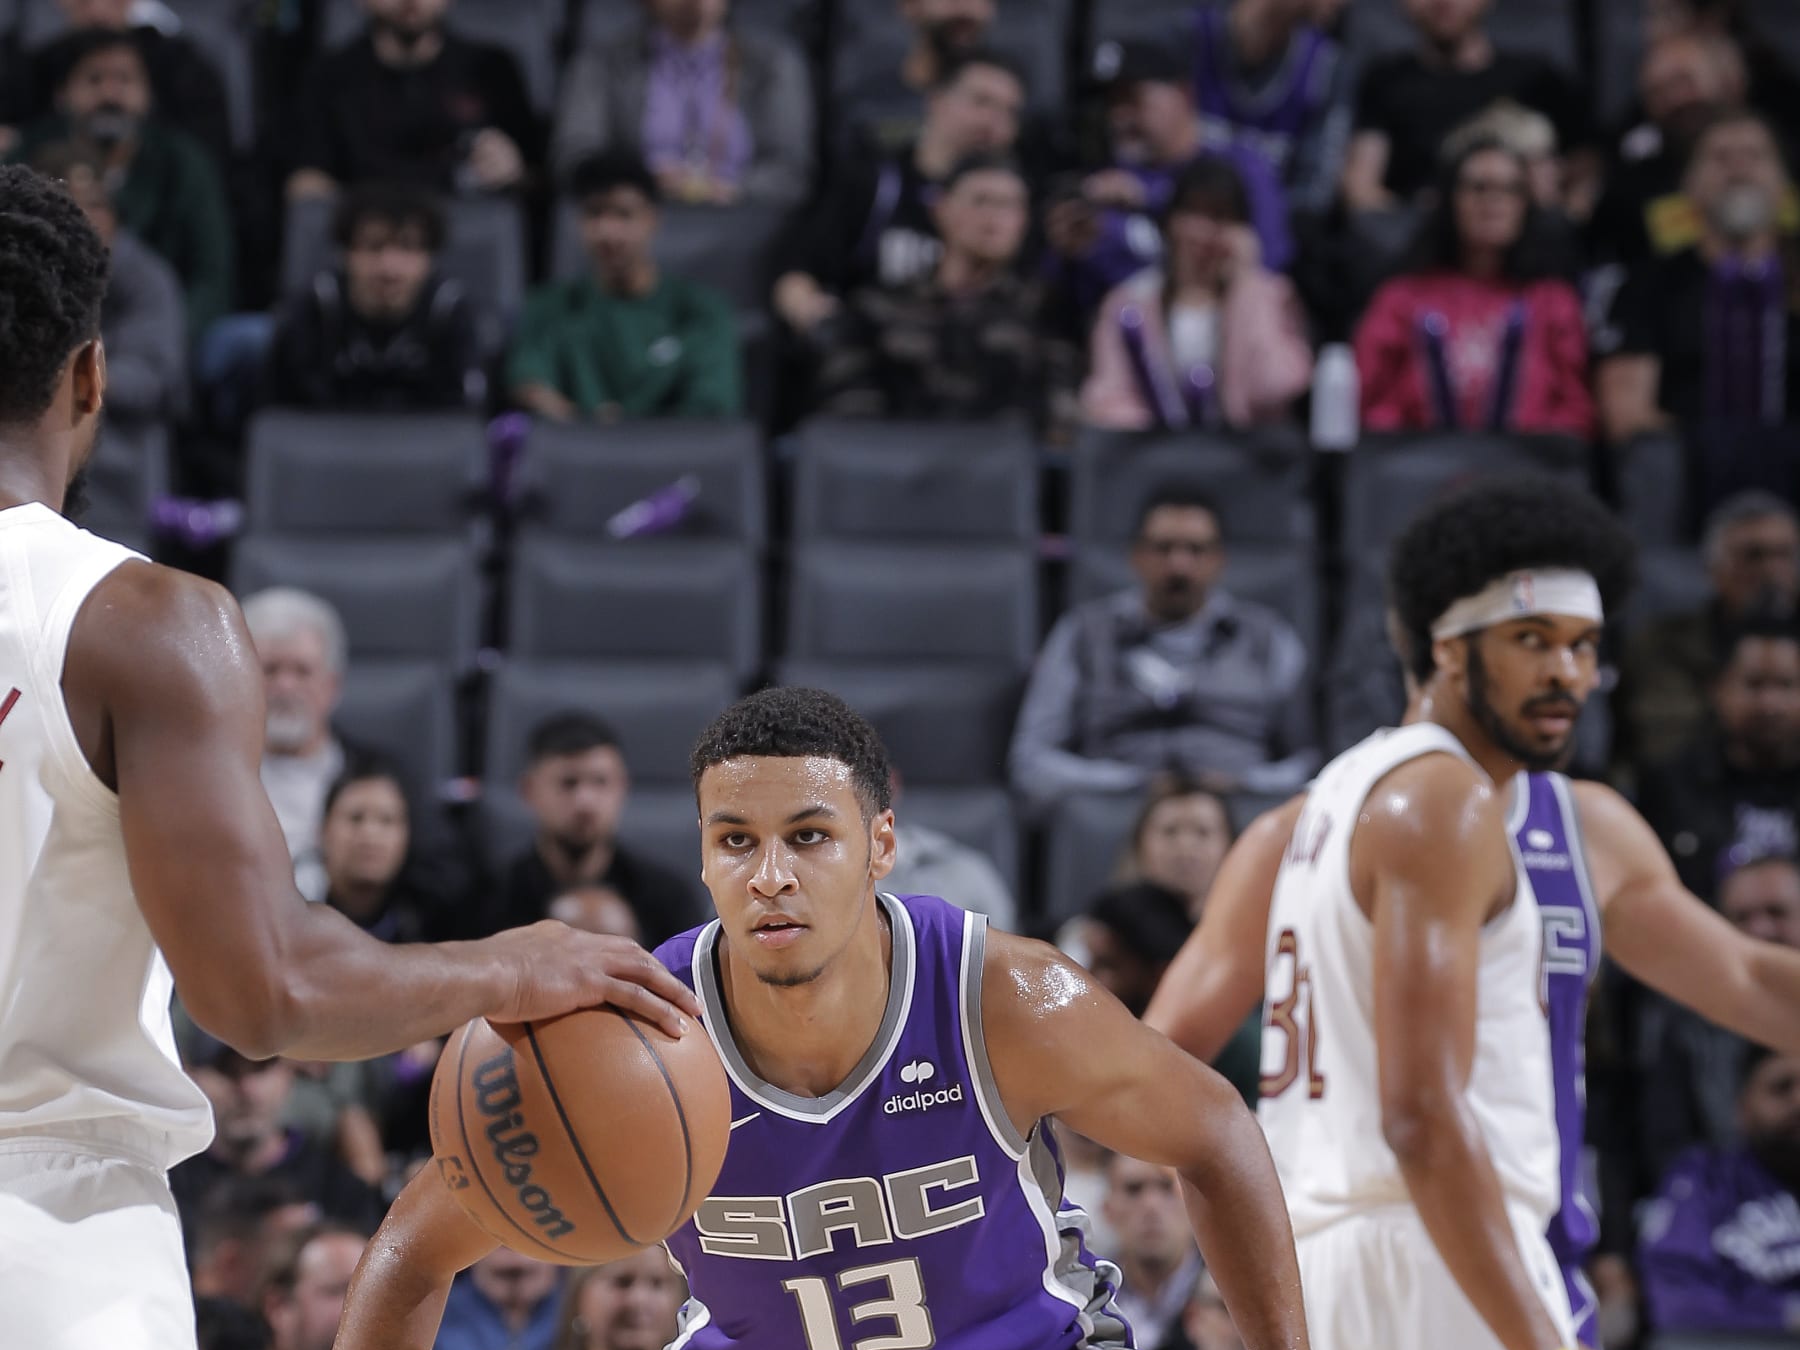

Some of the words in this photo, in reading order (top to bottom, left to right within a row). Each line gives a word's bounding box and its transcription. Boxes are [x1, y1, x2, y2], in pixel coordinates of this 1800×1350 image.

[472, 1047, 576, 1241] Wilson
[883, 1083, 963, 1114] dialpad
[693, 1155, 985, 1261] SAC
